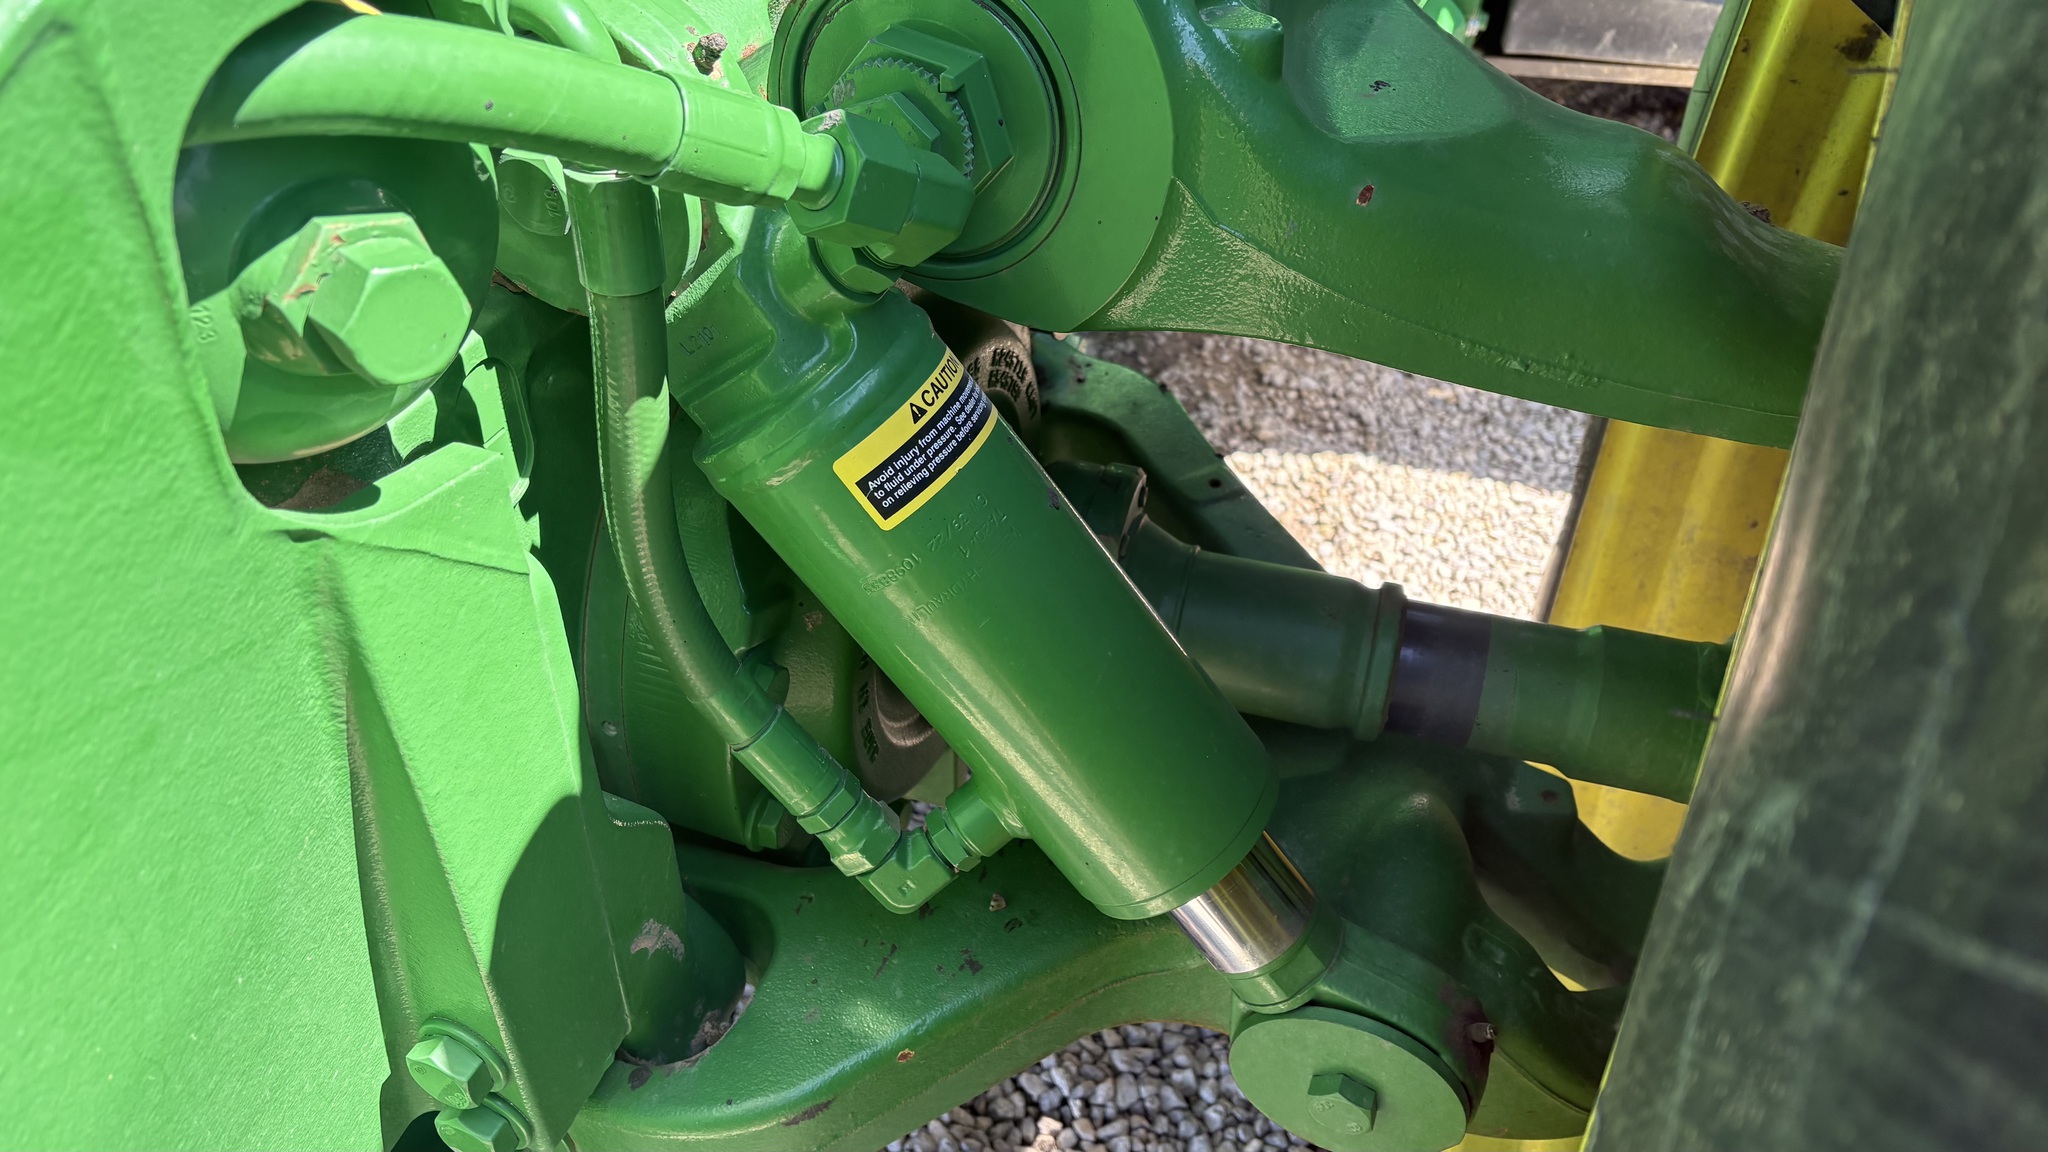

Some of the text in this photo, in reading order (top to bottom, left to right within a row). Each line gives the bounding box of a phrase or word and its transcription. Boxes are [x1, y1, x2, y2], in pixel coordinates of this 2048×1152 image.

[921, 353, 960, 407] CAUTION
[868, 466, 895, 491] Avoid
[893, 445, 920, 470] injury
[918, 428, 938, 448] from
[936, 401, 962, 430] machine
[873, 489, 885, 500] to
[884, 472, 905, 491] fluid
[904, 453, 927, 476] under
[926, 425, 957, 458] pressure.
[954, 411, 967, 425] See
[964, 396, 976, 414] dealer
[882, 497, 895, 508] on
[894, 468, 929, 499] relieving
[927, 440, 958, 473] pressure
[954, 419, 973, 442] before
